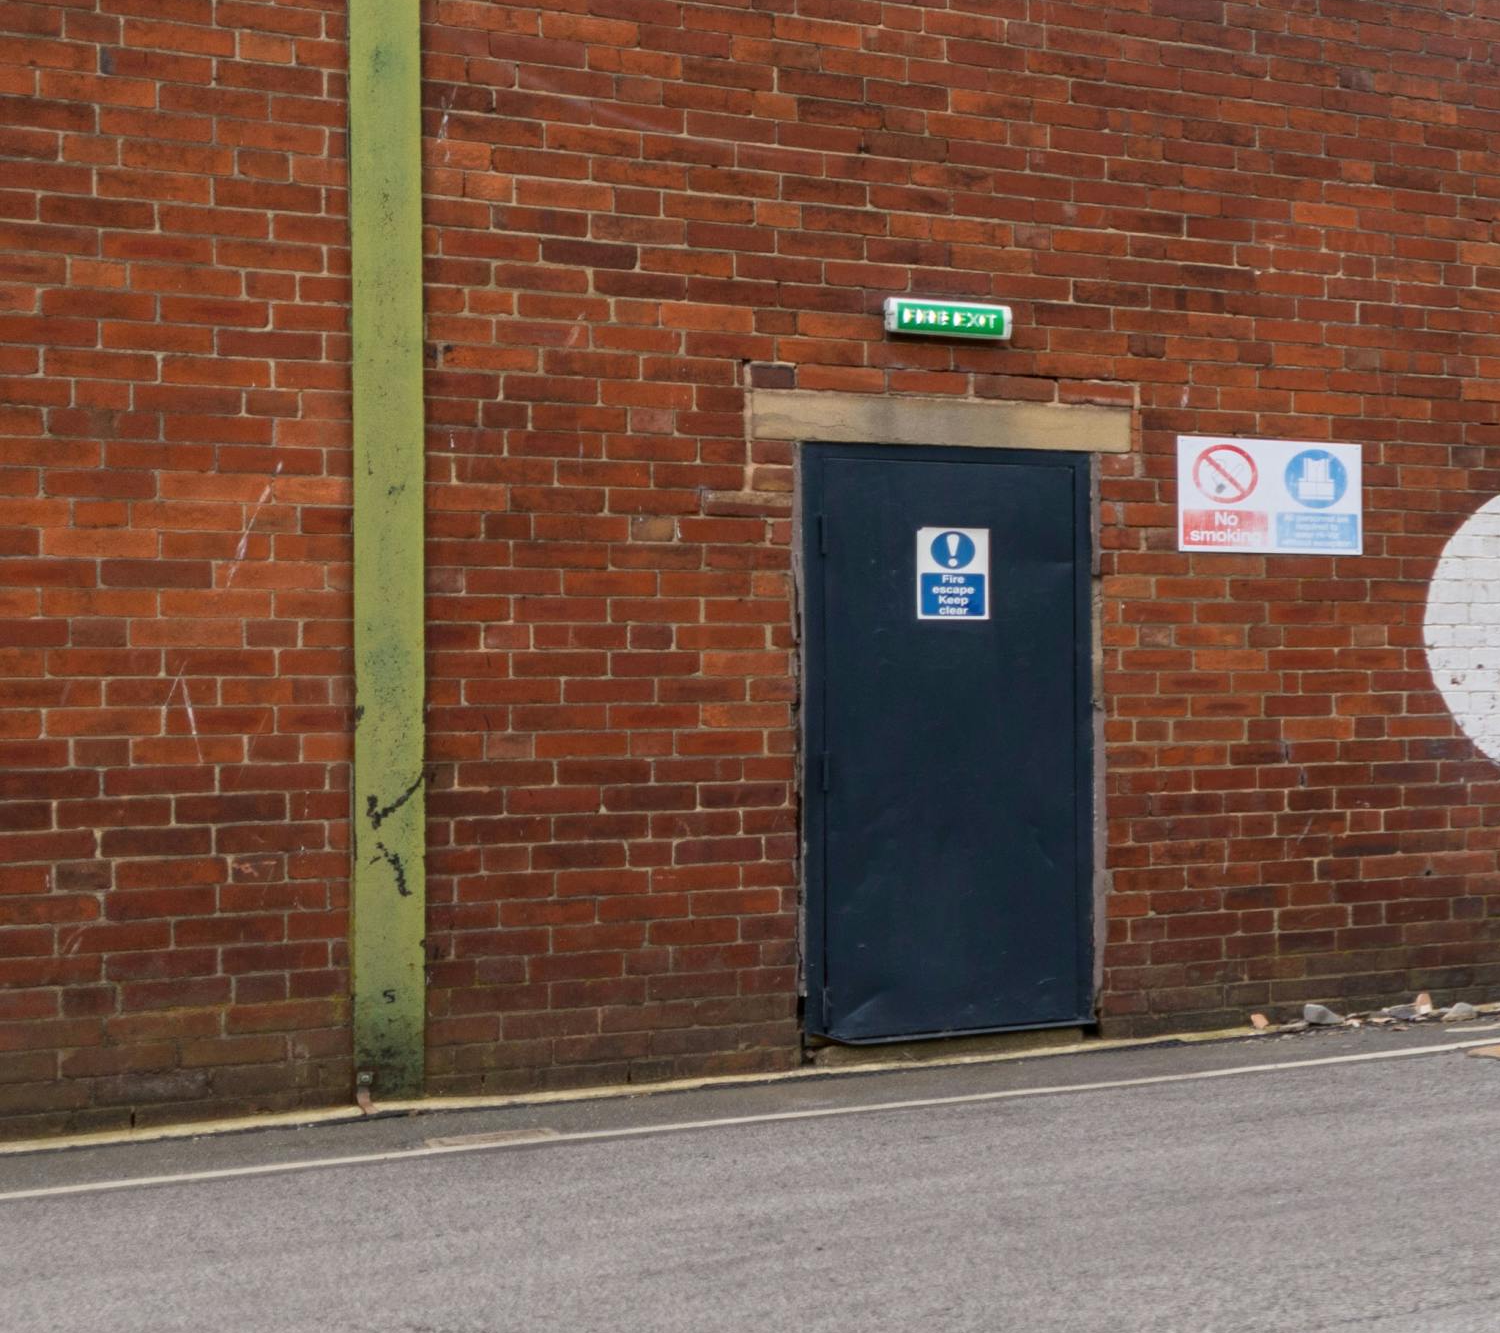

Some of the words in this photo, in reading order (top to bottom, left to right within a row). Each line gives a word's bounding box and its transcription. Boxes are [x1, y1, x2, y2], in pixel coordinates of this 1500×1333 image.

[902, 307, 949, 326] FIRE
[953, 311, 998, 329] EXIT
[1215, 511, 1239, 526] No
[942, 574, 965, 584] Fire
[932, 586, 975, 596] escape
[938, 595, 969, 606] Keep
[939, 606, 969, 615] clear
